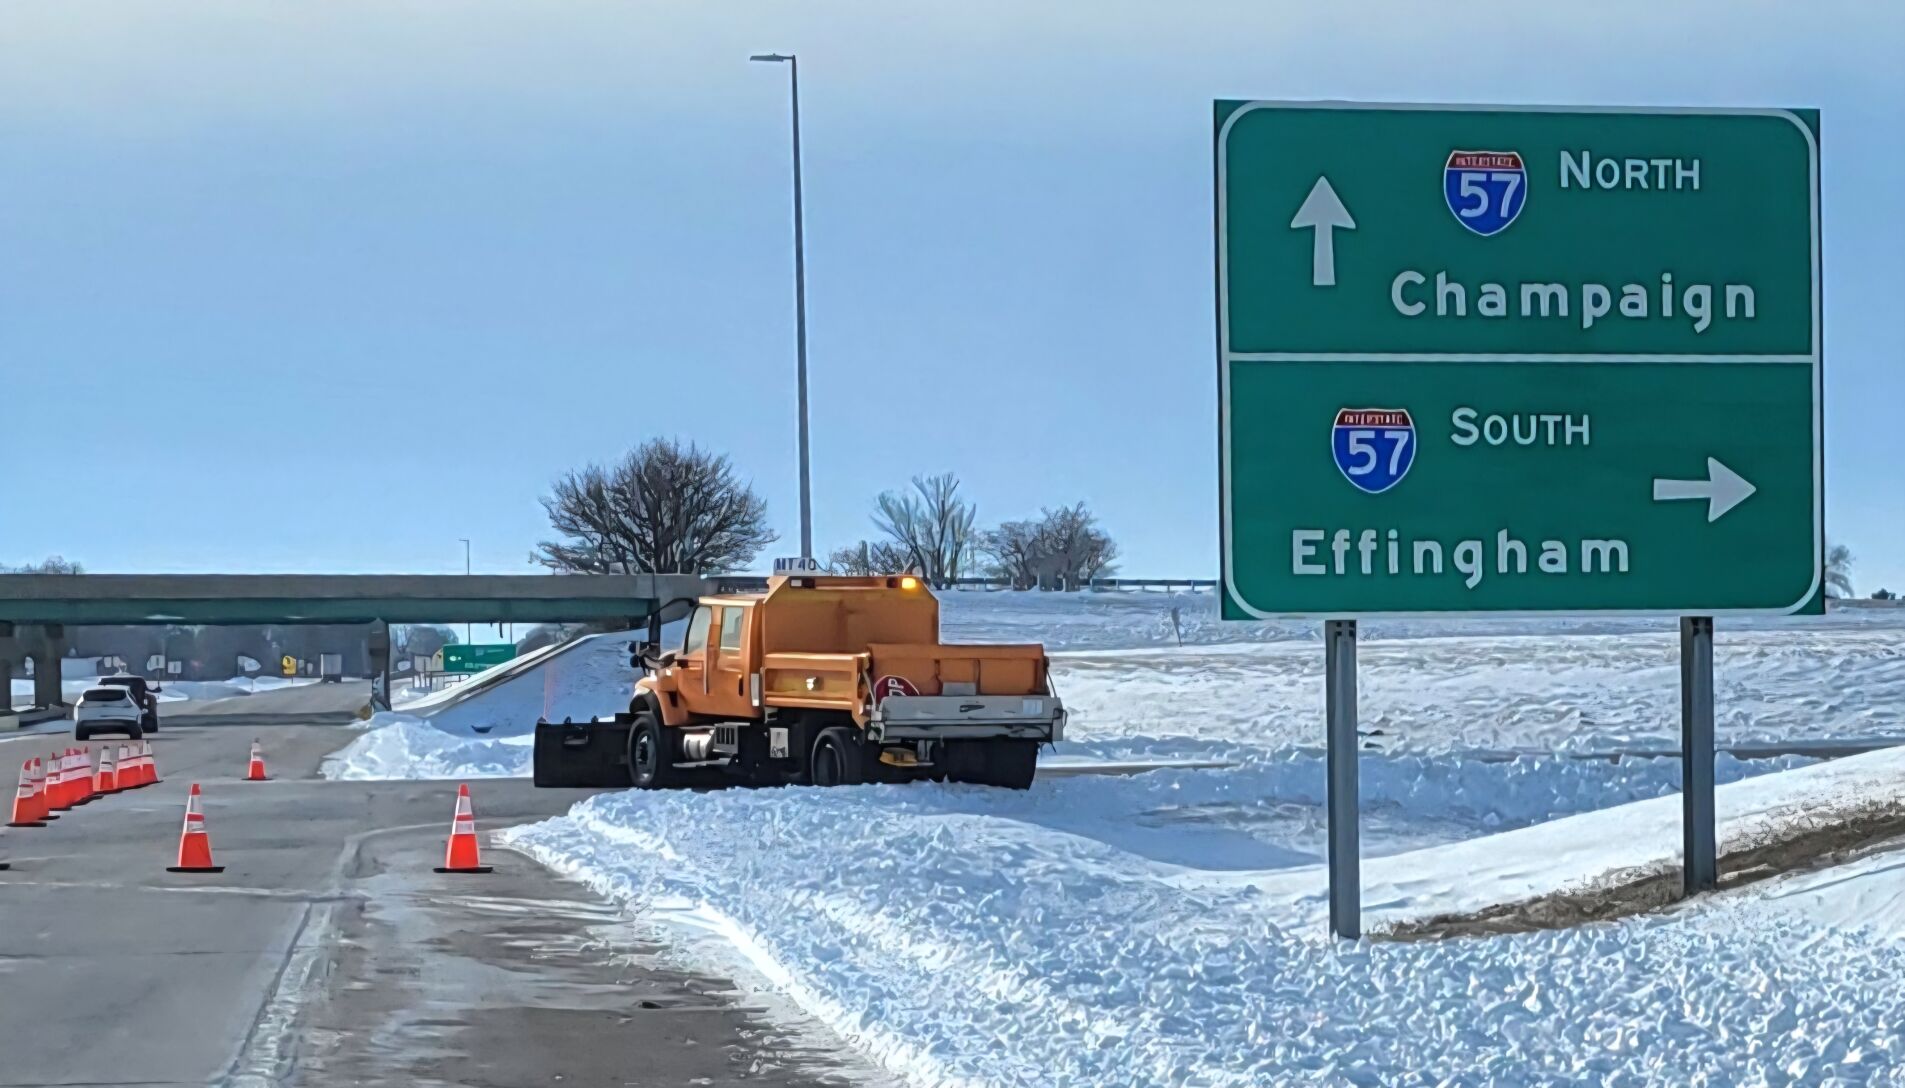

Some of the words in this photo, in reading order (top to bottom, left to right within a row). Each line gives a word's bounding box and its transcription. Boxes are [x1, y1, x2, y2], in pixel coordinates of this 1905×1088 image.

[1560, 150, 1700, 190] NORTH
[1460, 172, 1521, 218] 57
[1391, 270, 1756, 334] Champaign
[1450, 407, 1590, 446] SOUTH
[1347, 430, 1410, 476] 57
[1292, 528, 1630, 589] Effingham
